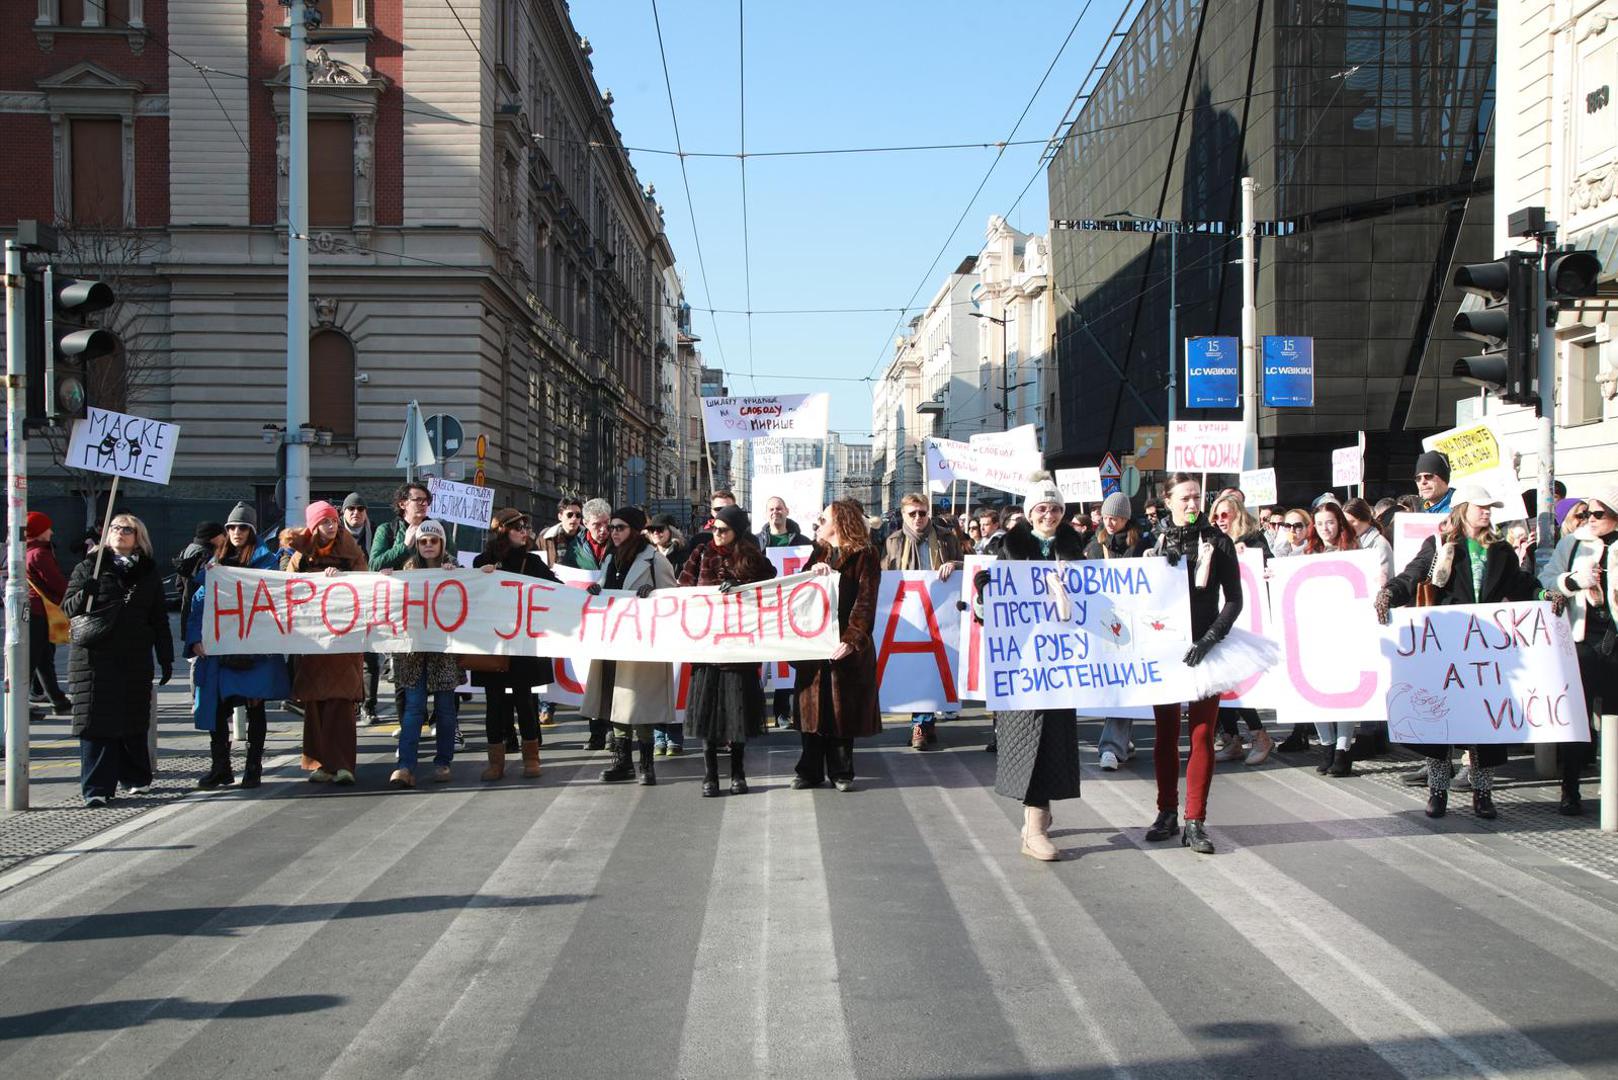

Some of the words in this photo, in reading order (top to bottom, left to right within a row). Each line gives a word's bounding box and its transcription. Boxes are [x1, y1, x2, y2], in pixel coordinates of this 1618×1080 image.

[1208, 341, 1219, 352] 15
[1283, 340, 1294, 351] 15
[1190, 368, 1201, 376] LC
[1265, 367, 1277, 375] LC
[739, 405, 782, 417] СЛОБОДУ
[751, 419, 795, 431] МИРИШЕ
[89, 411, 167, 449] МАСКЕ
[1174, 443, 1241, 469] ПОСТОЈИМ
[988, 567, 1018, 597] НА
[213, 577, 468, 643] НАРОДНО
[494, 580, 556, 641] ЈЕ
[580, 582, 831, 647] НАРОДНО
[1397, 616, 1442, 656] JA
[1463, 607, 1552, 651] ASKA
[988, 635, 1022, 663] НА
[1034, 632, 1089, 662] РУБУ
[994, 658, 1163, 697] ЕГЗИСТЕНЦИЈЕ
[1483, 684, 1571, 731] VUČIĆ
